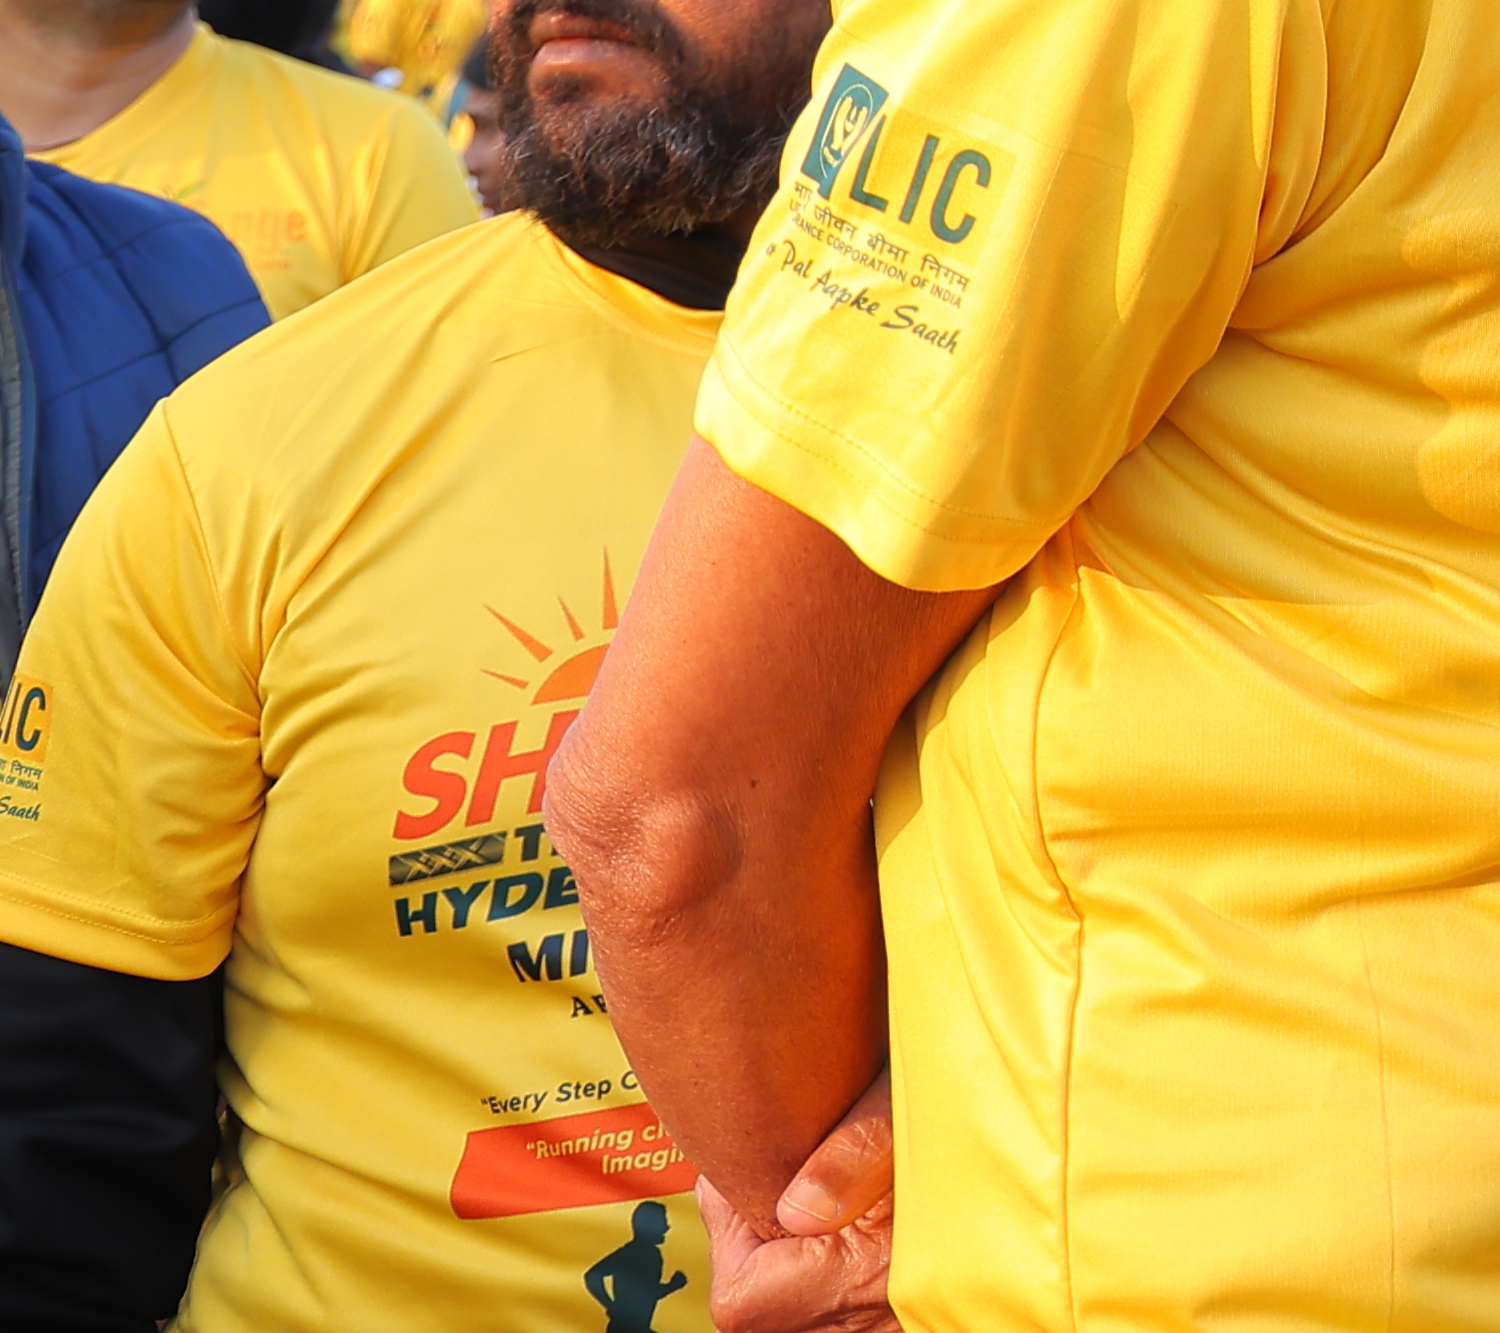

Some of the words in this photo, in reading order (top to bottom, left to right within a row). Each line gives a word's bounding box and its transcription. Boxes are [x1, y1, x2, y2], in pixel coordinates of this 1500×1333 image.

[849, 113, 992, 245] LIC
[813, 204, 860, 241] जीवन
[867, 224, 911, 265] बीमा
[920, 252, 971, 293] निगम
[826, 227, 908, 283] CORPORATION
[910, 275, 929, 290] OF
[929, 282, 962, 310] INDIA
[781, 239, 812, 279] Pal
[809, 269, 881, 318] Aapke
[880, 304, 959, 355] Saath
[555, 1075, 612, 1105] Step
